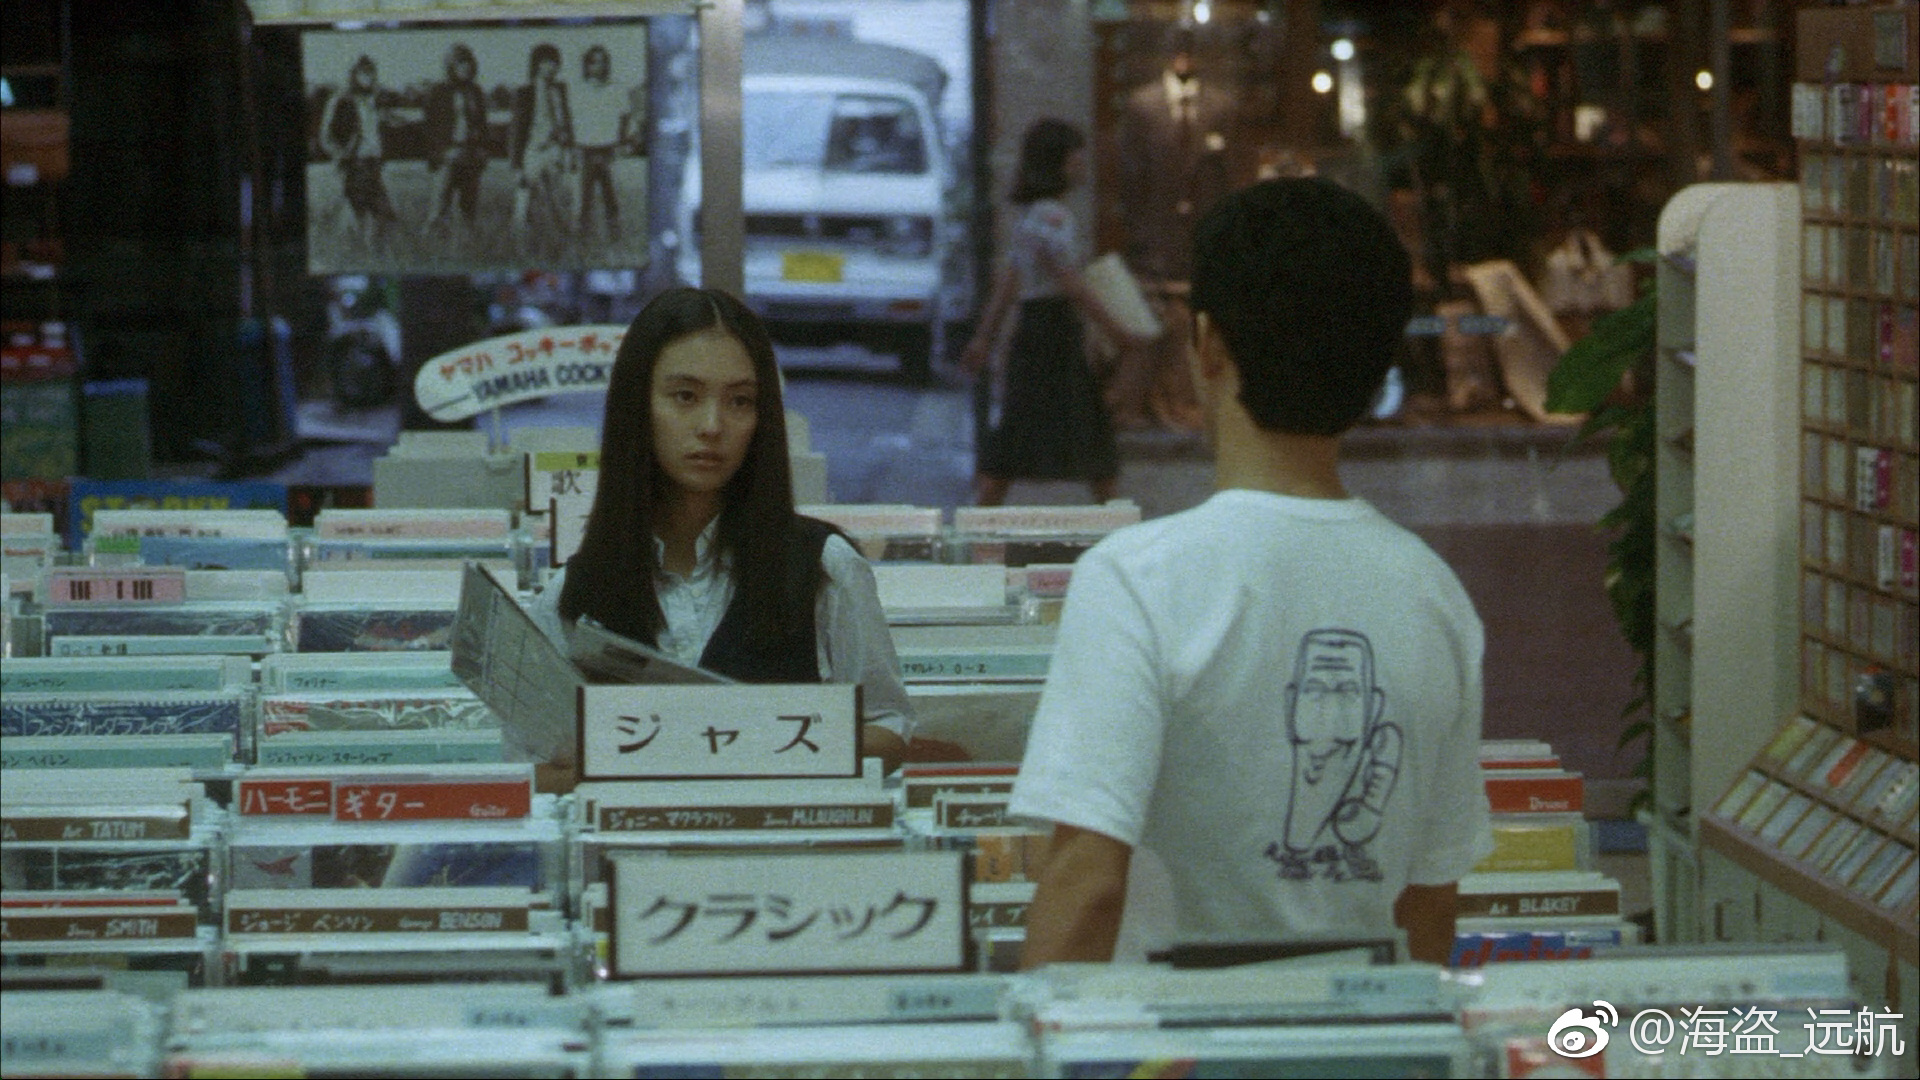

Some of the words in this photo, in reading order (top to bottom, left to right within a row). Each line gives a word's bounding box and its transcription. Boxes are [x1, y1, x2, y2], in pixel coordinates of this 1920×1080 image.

[439, 352, 493, 381] ヤマハ
[507, 333, 625, 365] コッキーポッ
[473, 366, 549, 402] YAMAHA
[615, 713, 823, 755] ジャズ
[243, 786, 328, 813] ハーモニ
[346, 788, 425, 819] ギター
[90, 820, 146, 839] TATUM
[609, 810, 660, 831] ジョニー
[640, 890, 938, 945] クラシック
[1519, 896, 1580, 914] BLAKEY
[104, 919, 158, 938] SMITH
[240, 912, 301, 931] ジョージ
[439, 911, 502, 929] BENSON
